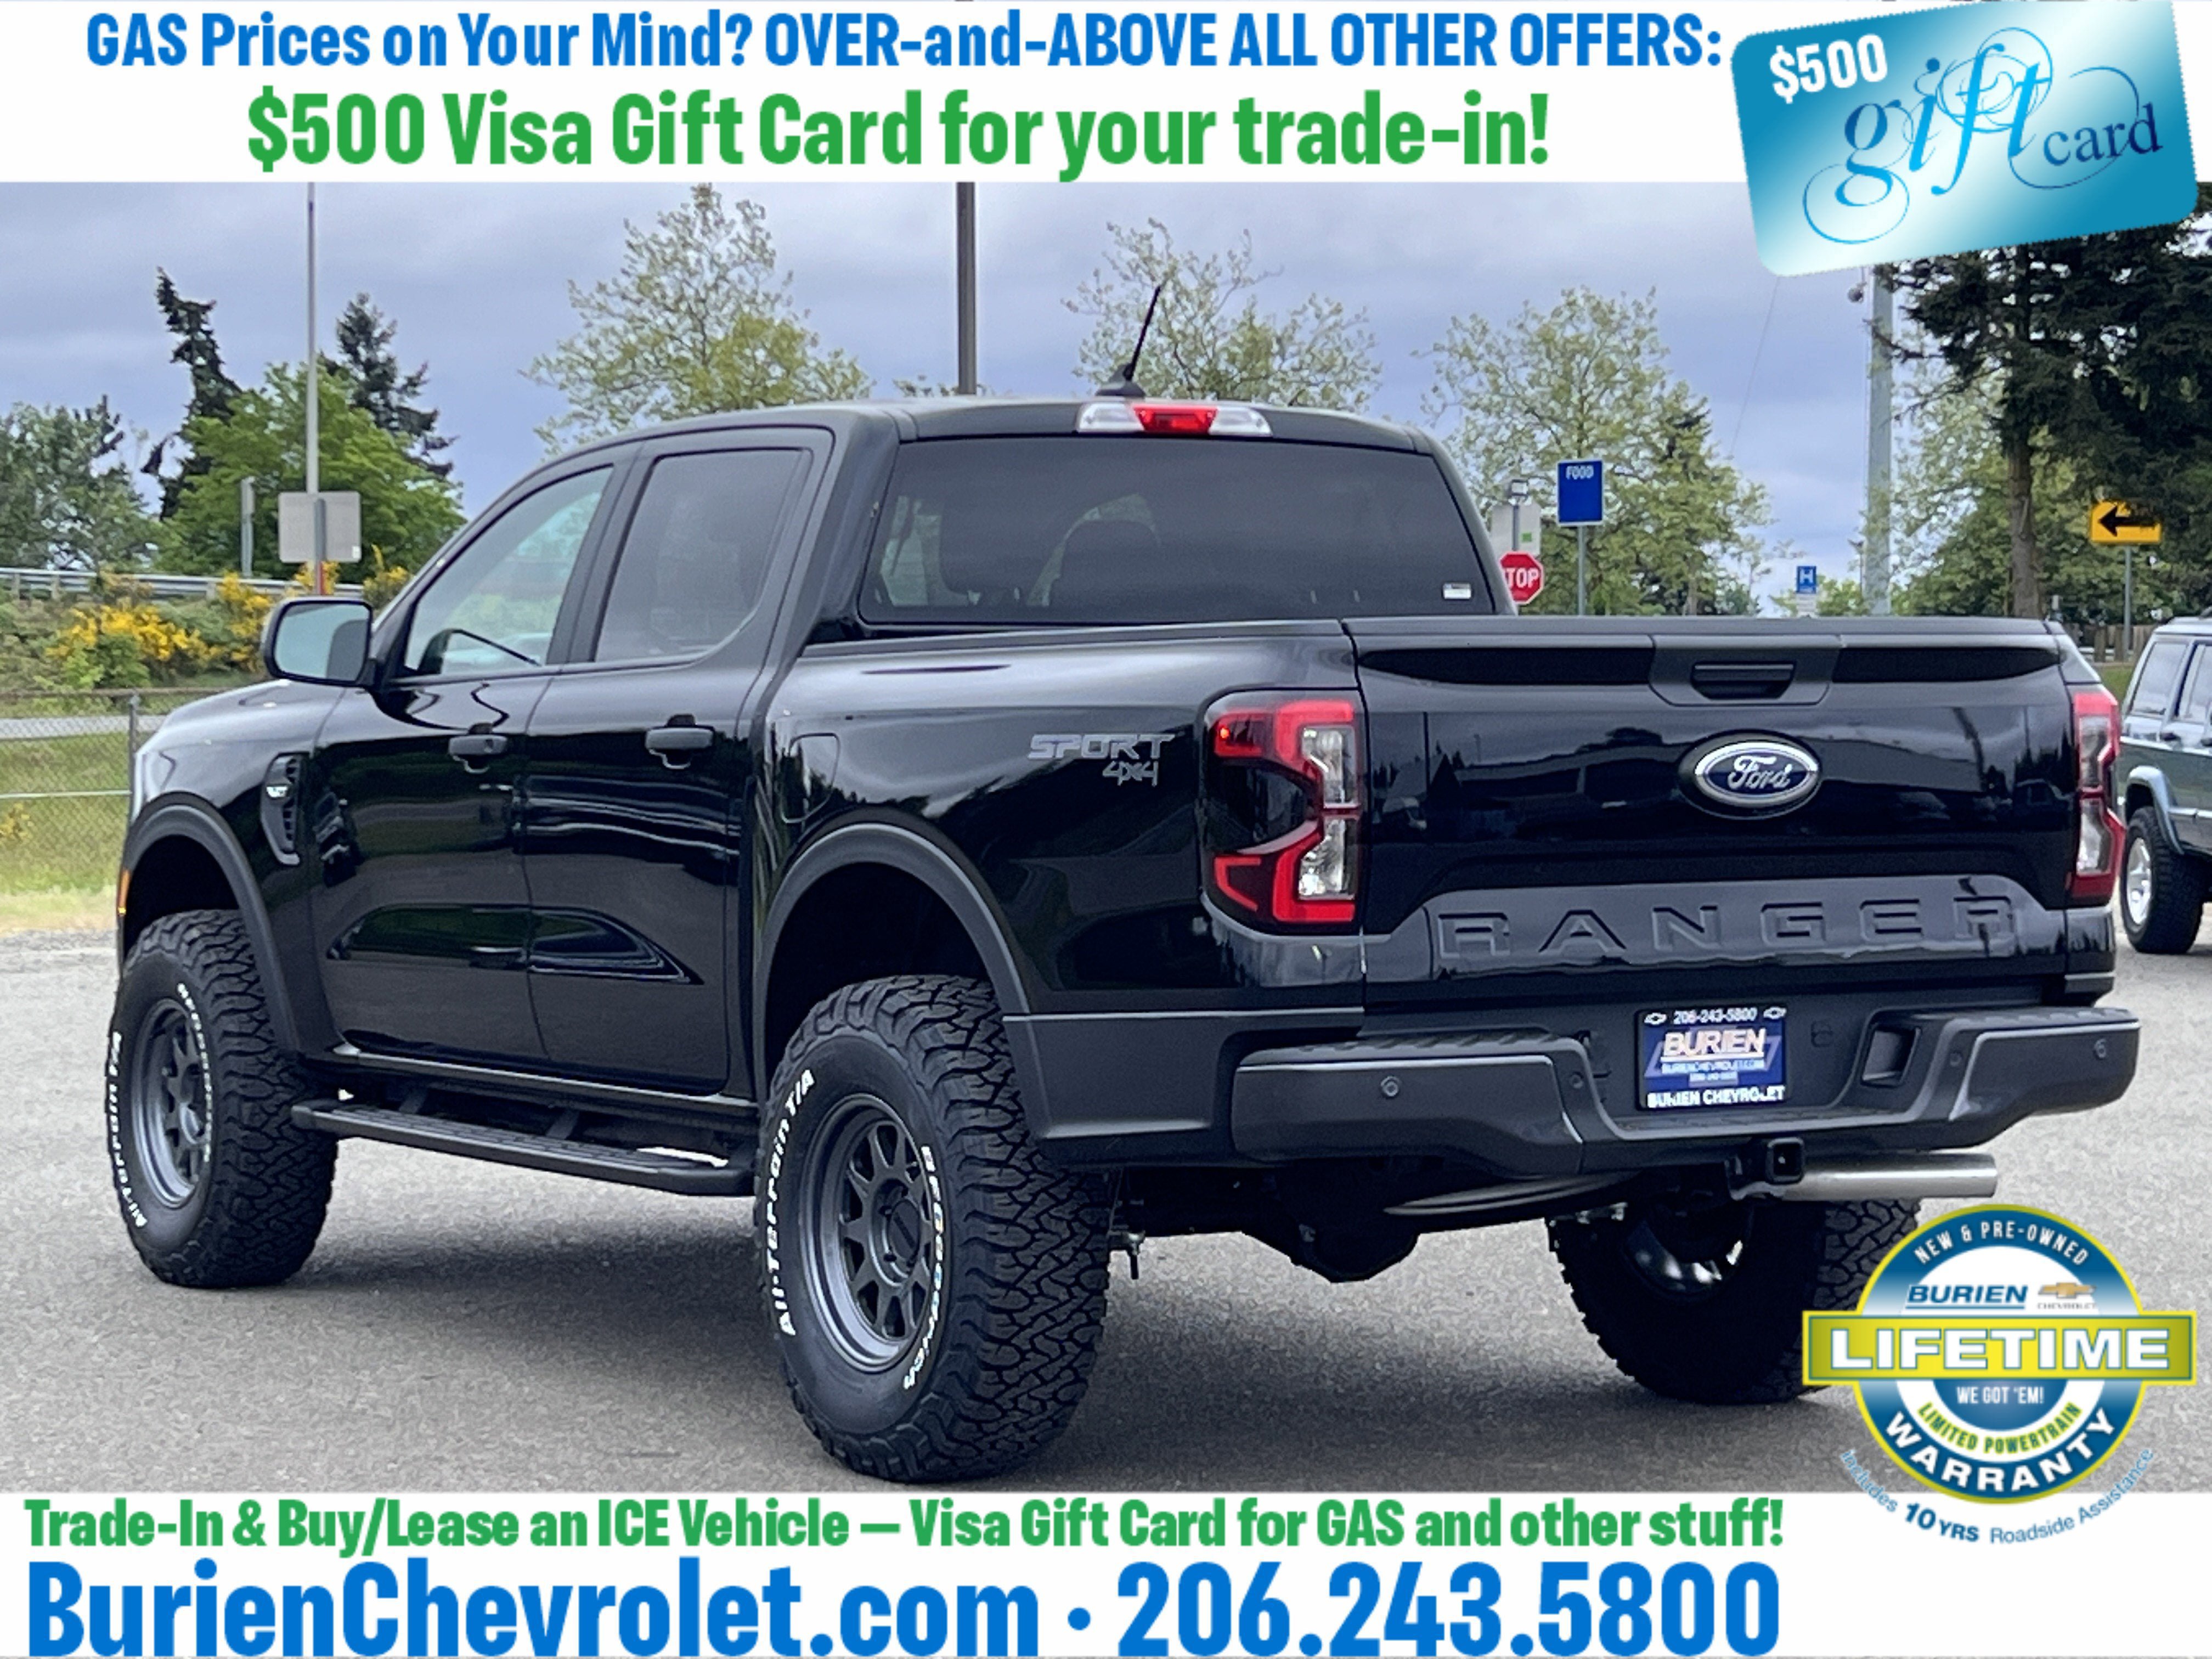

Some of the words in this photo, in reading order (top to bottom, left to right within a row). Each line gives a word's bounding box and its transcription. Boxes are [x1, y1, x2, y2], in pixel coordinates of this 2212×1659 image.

[1565, 465, 1594, 479] FOOD
[1504, 567, 1539, 589] TOP
[1028, 733, 1176, 760] SPORT
[1728, 755, 1792, 789] Ford
[1437, 895, 2016, 959] RANGER
[1663, 1028, 1767, 1057] BURIEN
[785, 1069, 815, 1116] T/A
[1646, 1090, 1701, 1108] BURIEN
